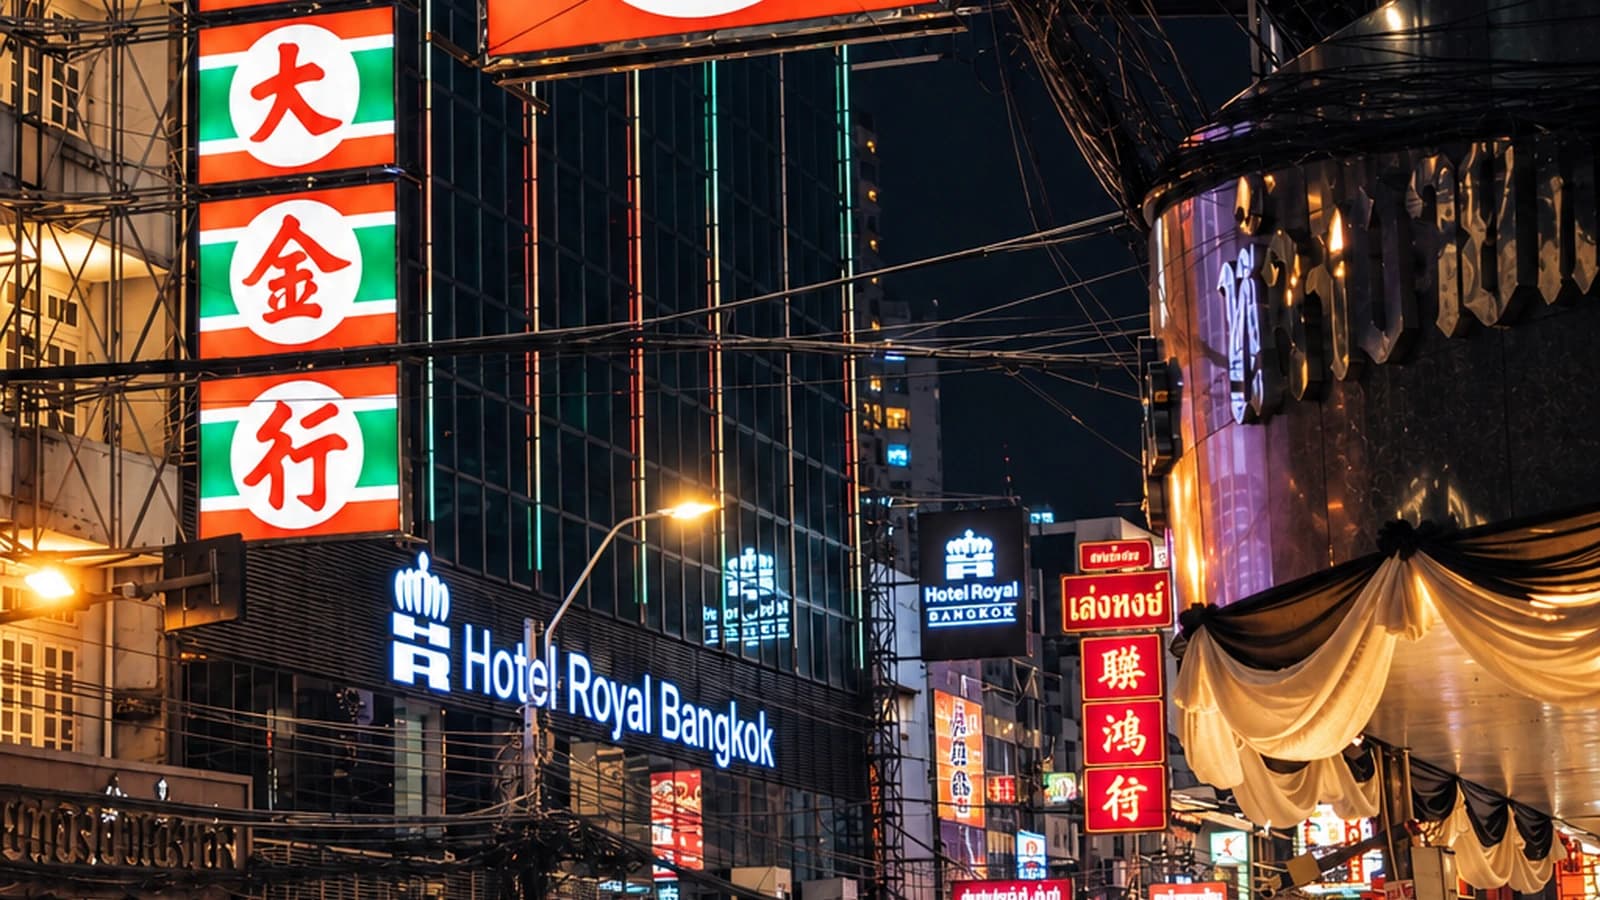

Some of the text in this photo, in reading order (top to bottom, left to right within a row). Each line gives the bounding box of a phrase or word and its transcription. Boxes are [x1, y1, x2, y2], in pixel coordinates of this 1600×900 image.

[242, 42, 351, 511] 大金行
[924, 581, 1018, 603] Hotel Royal
[464, 622, 774, 767] Hotel Royal Bangkok
